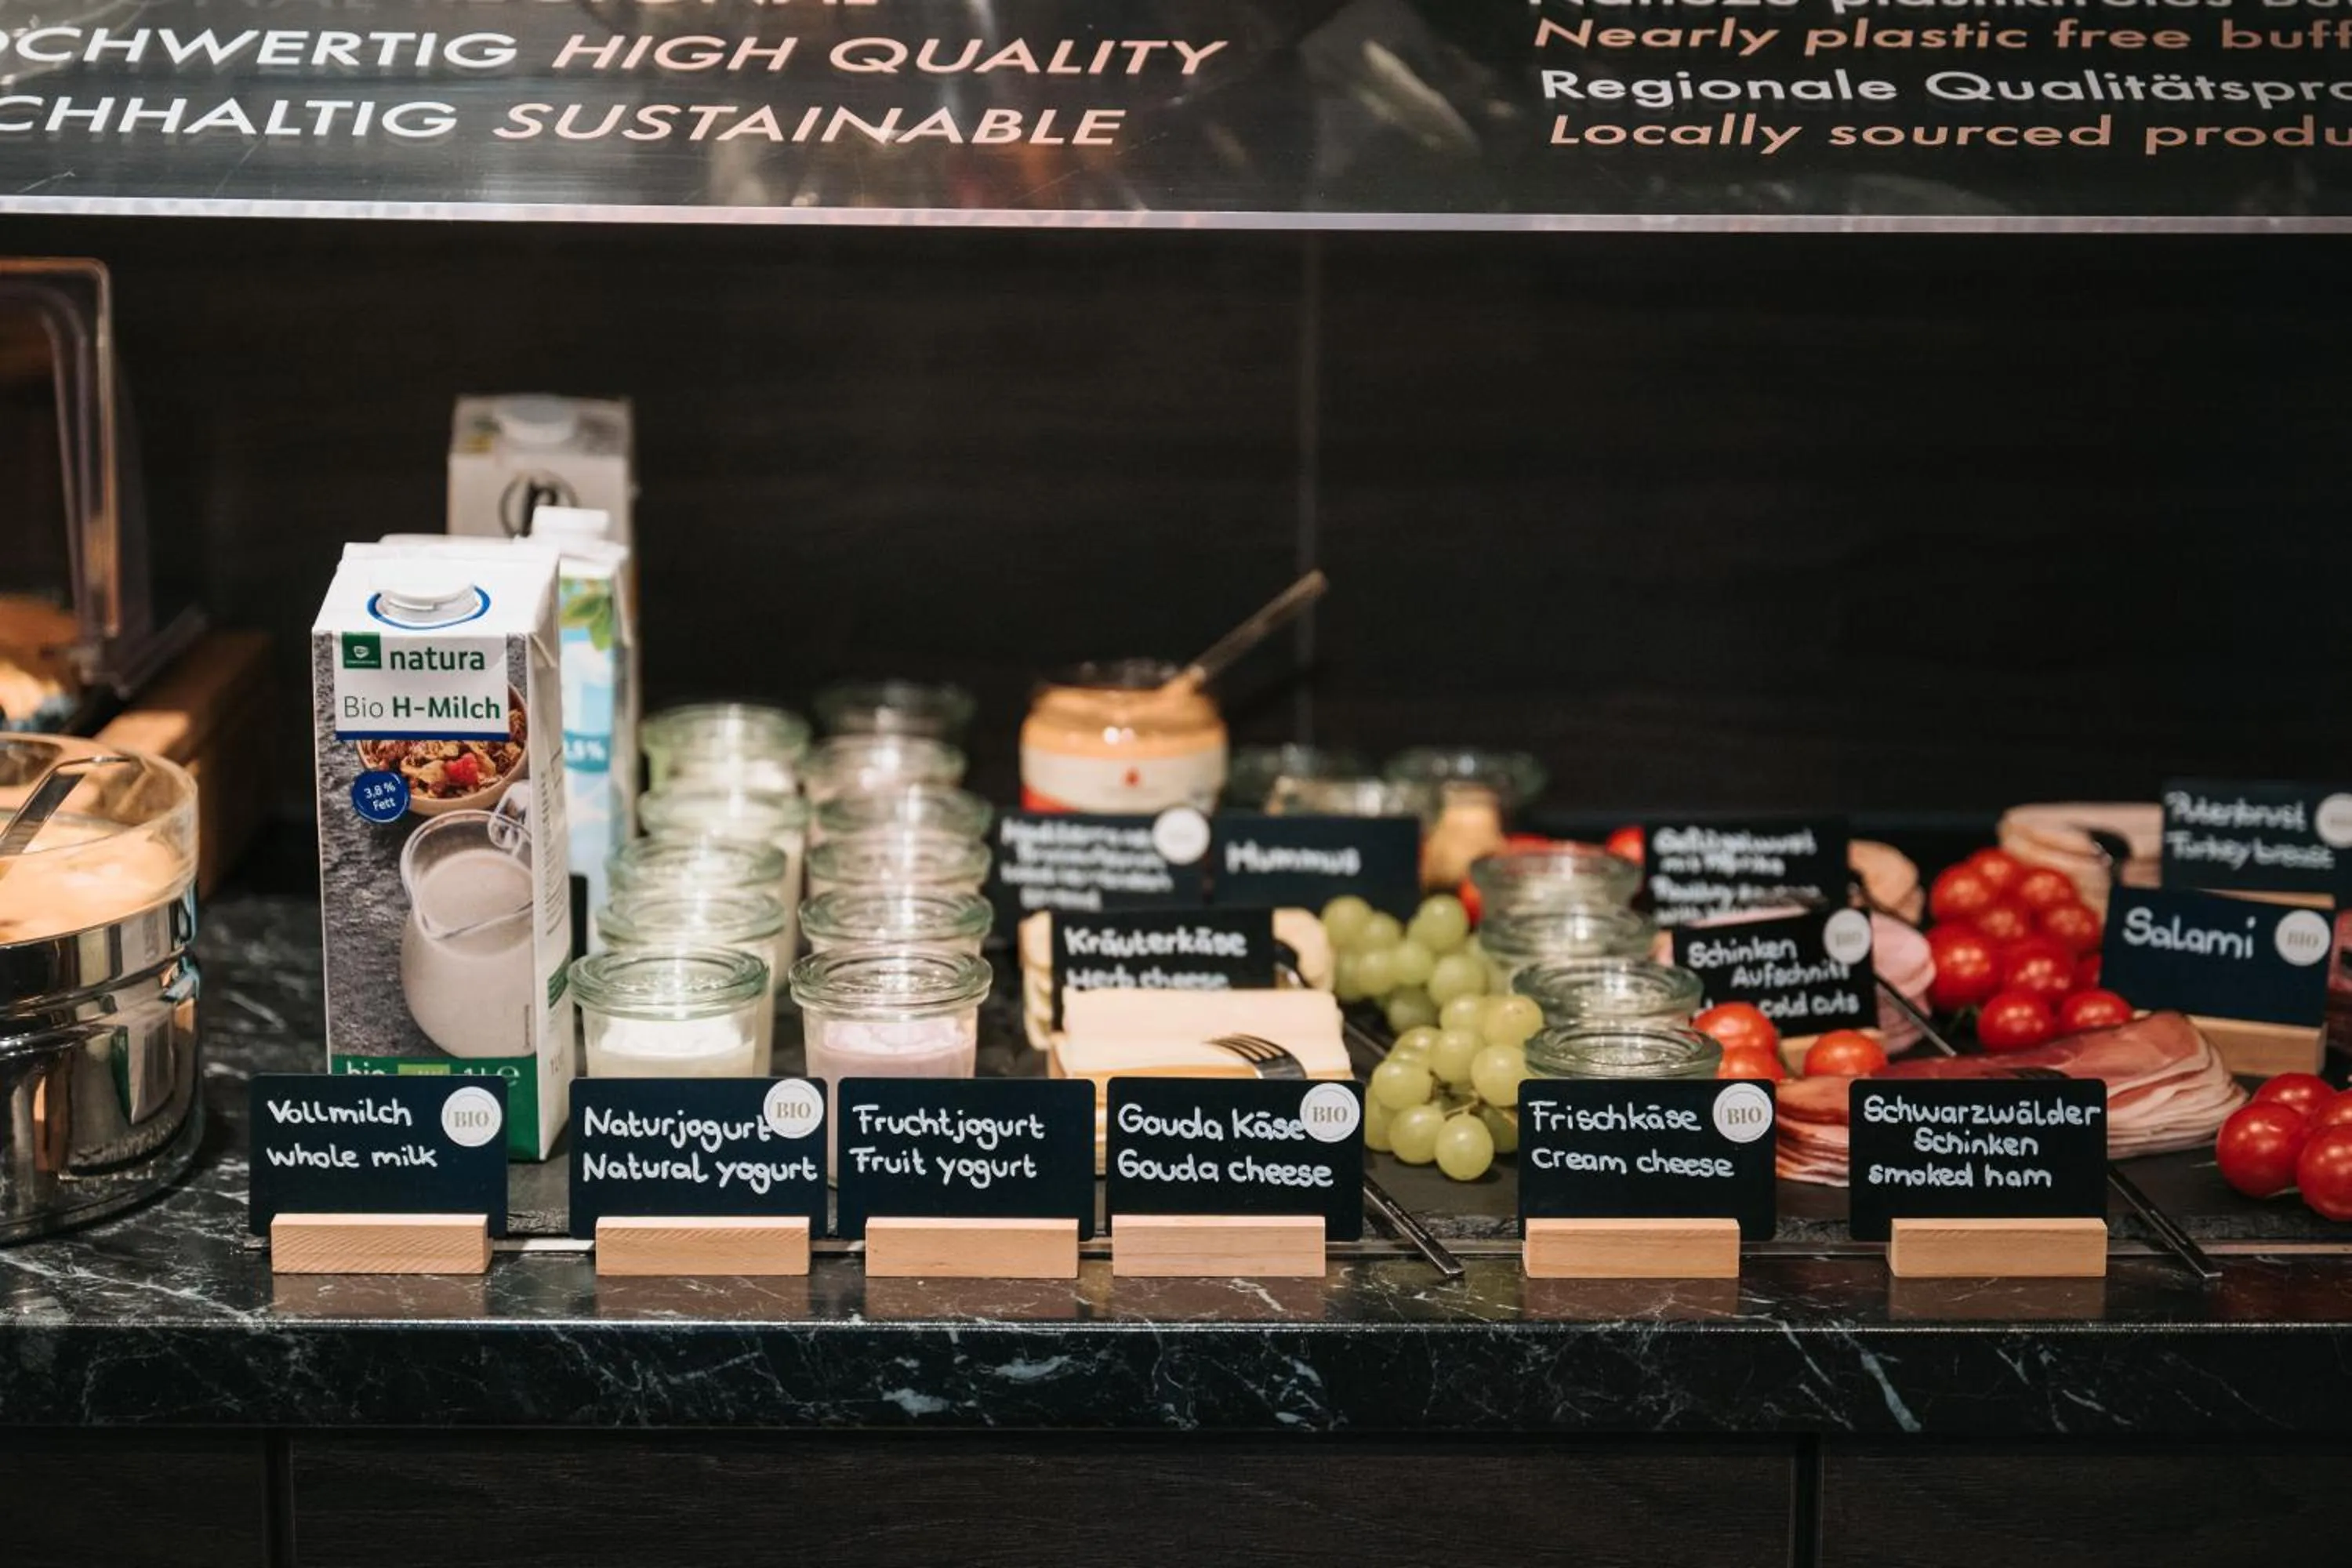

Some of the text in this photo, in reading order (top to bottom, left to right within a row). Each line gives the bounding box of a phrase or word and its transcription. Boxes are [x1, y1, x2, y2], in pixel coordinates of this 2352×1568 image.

[0, 27, 1229, 75] CHWERTIG HIGH QUALITY
[1534, 18, 1780, 56] Nearly
[1804, 17, 2027, 56] plastic
[2053, 18, 2191, 49] free
[1541, 69, 1897, 109] Regionale
[492, 103, 1126, 146] SUSTAINABLE
[1551, 113, 1802, 154] Locally
[1828, 114, 2111, 147] sourced
[390, 646, 486, 671] natura
[343, 695, 501, 720] Bio H-Milch
[372, 797, 397, 812] Fett
[1064, 925, 1248, 958] Kräuterkäse
[2122, 906, 2257, 960] Salami
[1687, 935, 1798, 969] Schinken
[1811, 989, 1860, 1016] cuts
[267, 1098, 413, 1127] Vollmilch
[454, 1110, 490, 1129] BIO
[776, 1101, 811, 1119] BIO
[1117, 1102, 1306, 1142] Gouda Käse
[1312, 1105, 1348, 1123] BIO
[1528, 1100, 1702, 1132] Frischkäse
[1726, 1107, 1762, 1126] BIO
[1863, 1094, 2102, 1127] Schwarzwälder
[584, 1106, 771, 1153] Naturjogurt
[852, 1104, 1046, 1151] Fruchtjogurt
[1914, 1127, 2039, 1156] Schinken
[267, 1143, 439, 1169] whole milk
[848, 1146, 1038, 1189] Fruit yogurt
[1117, 1149, 1334, 1188] Gouda cheese
[1531, 1146, 1735, 1178] Cream cheese
[583, 1151, 818, 1195] Natural yogurt
[1868, 1161, 2053, 1189] smoked ham
